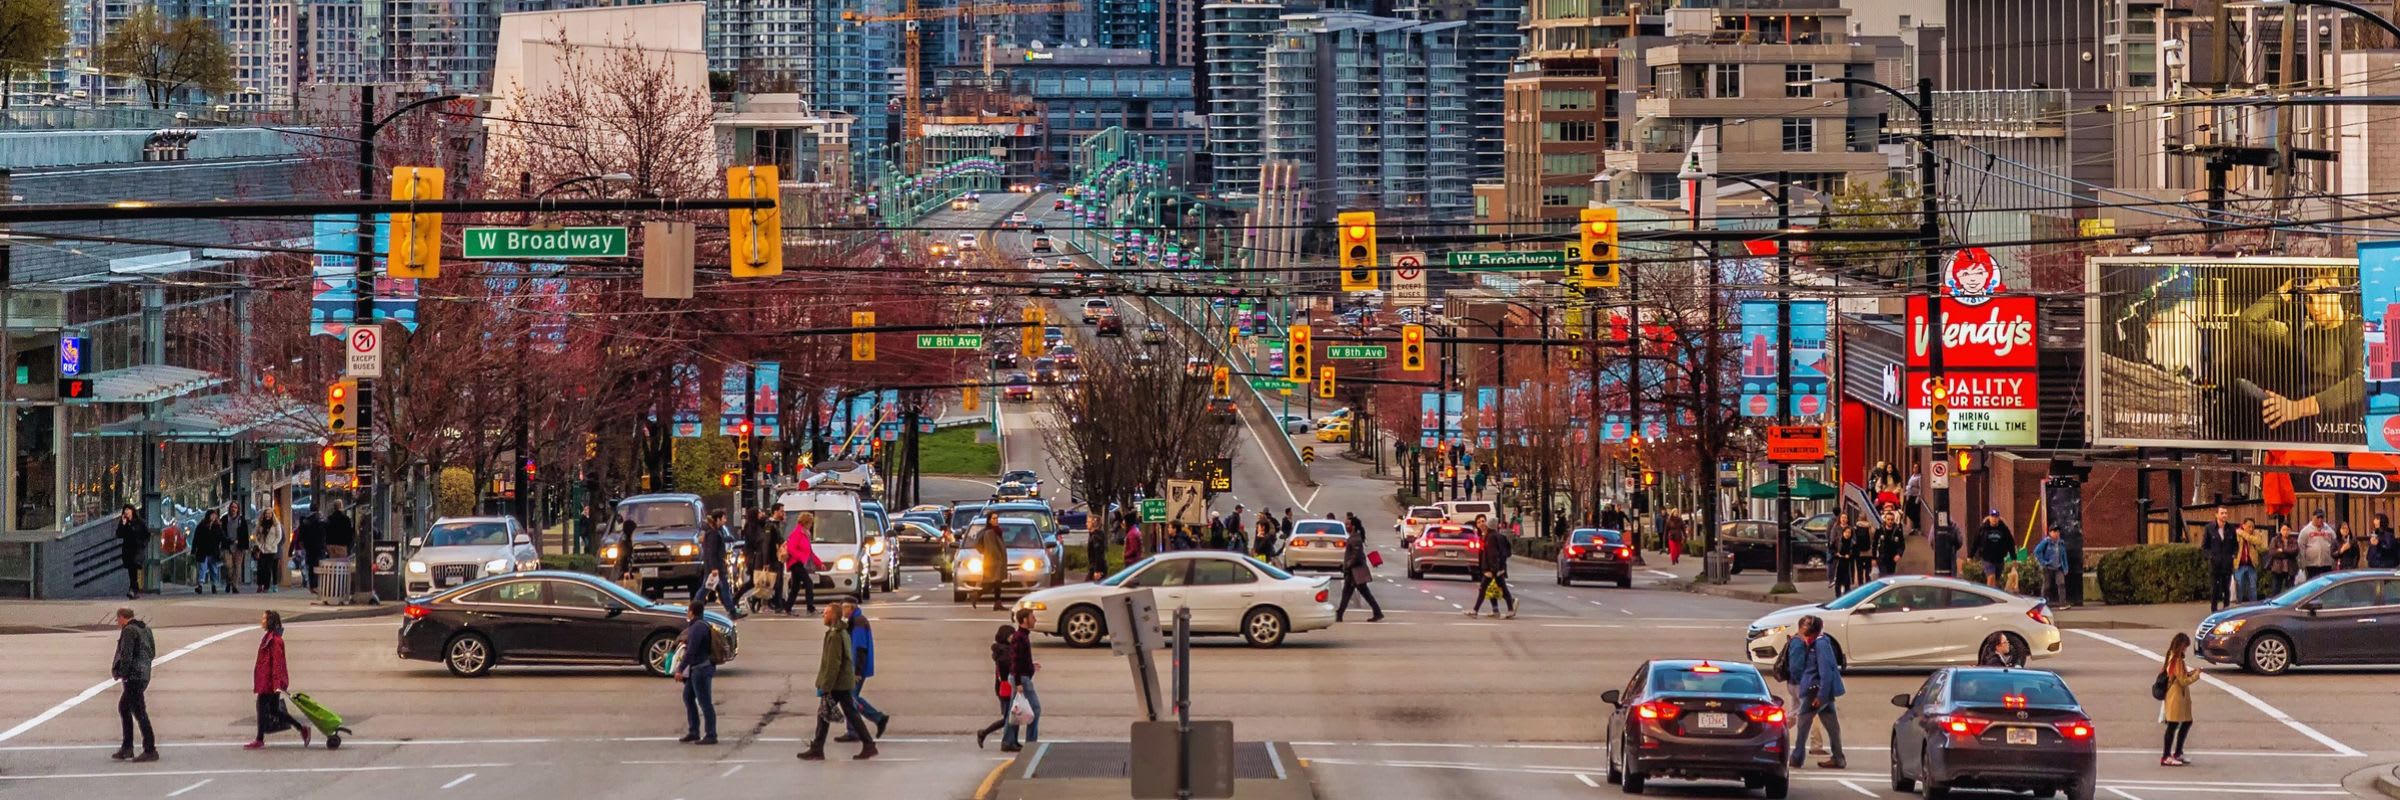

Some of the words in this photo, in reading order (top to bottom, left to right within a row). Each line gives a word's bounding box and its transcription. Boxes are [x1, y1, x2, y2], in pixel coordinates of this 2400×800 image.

[479, 232, 496, 249] W
[508, 231, 612, 253] Broadway
[1457, 254, 1472, 265] W
[1480, 254, 1557, 268] Broadway
[1915, 307, 2032, 356] Wendy's
[922, 338, 931, 346] W
[936, 337, 954, 346] 8th
[959, 337, 977, 346] Ave
[1331, 348, 1340, 357] W
[1345, 348, 1361, 357] 8th
[1365, 348, 1383, 357] Ave
[63, 363, 77, 372] RBC
[1947, 396, 1968, 406] UR
[1959, 412, 1990, 420] HIRING
[1953, 422, 1974, 430] TIME
[1977, 422, 1999, 430] FULL
[2006, 422, 2027, 430] TIME
[2316, 474, 2381, 490] PATTISON
